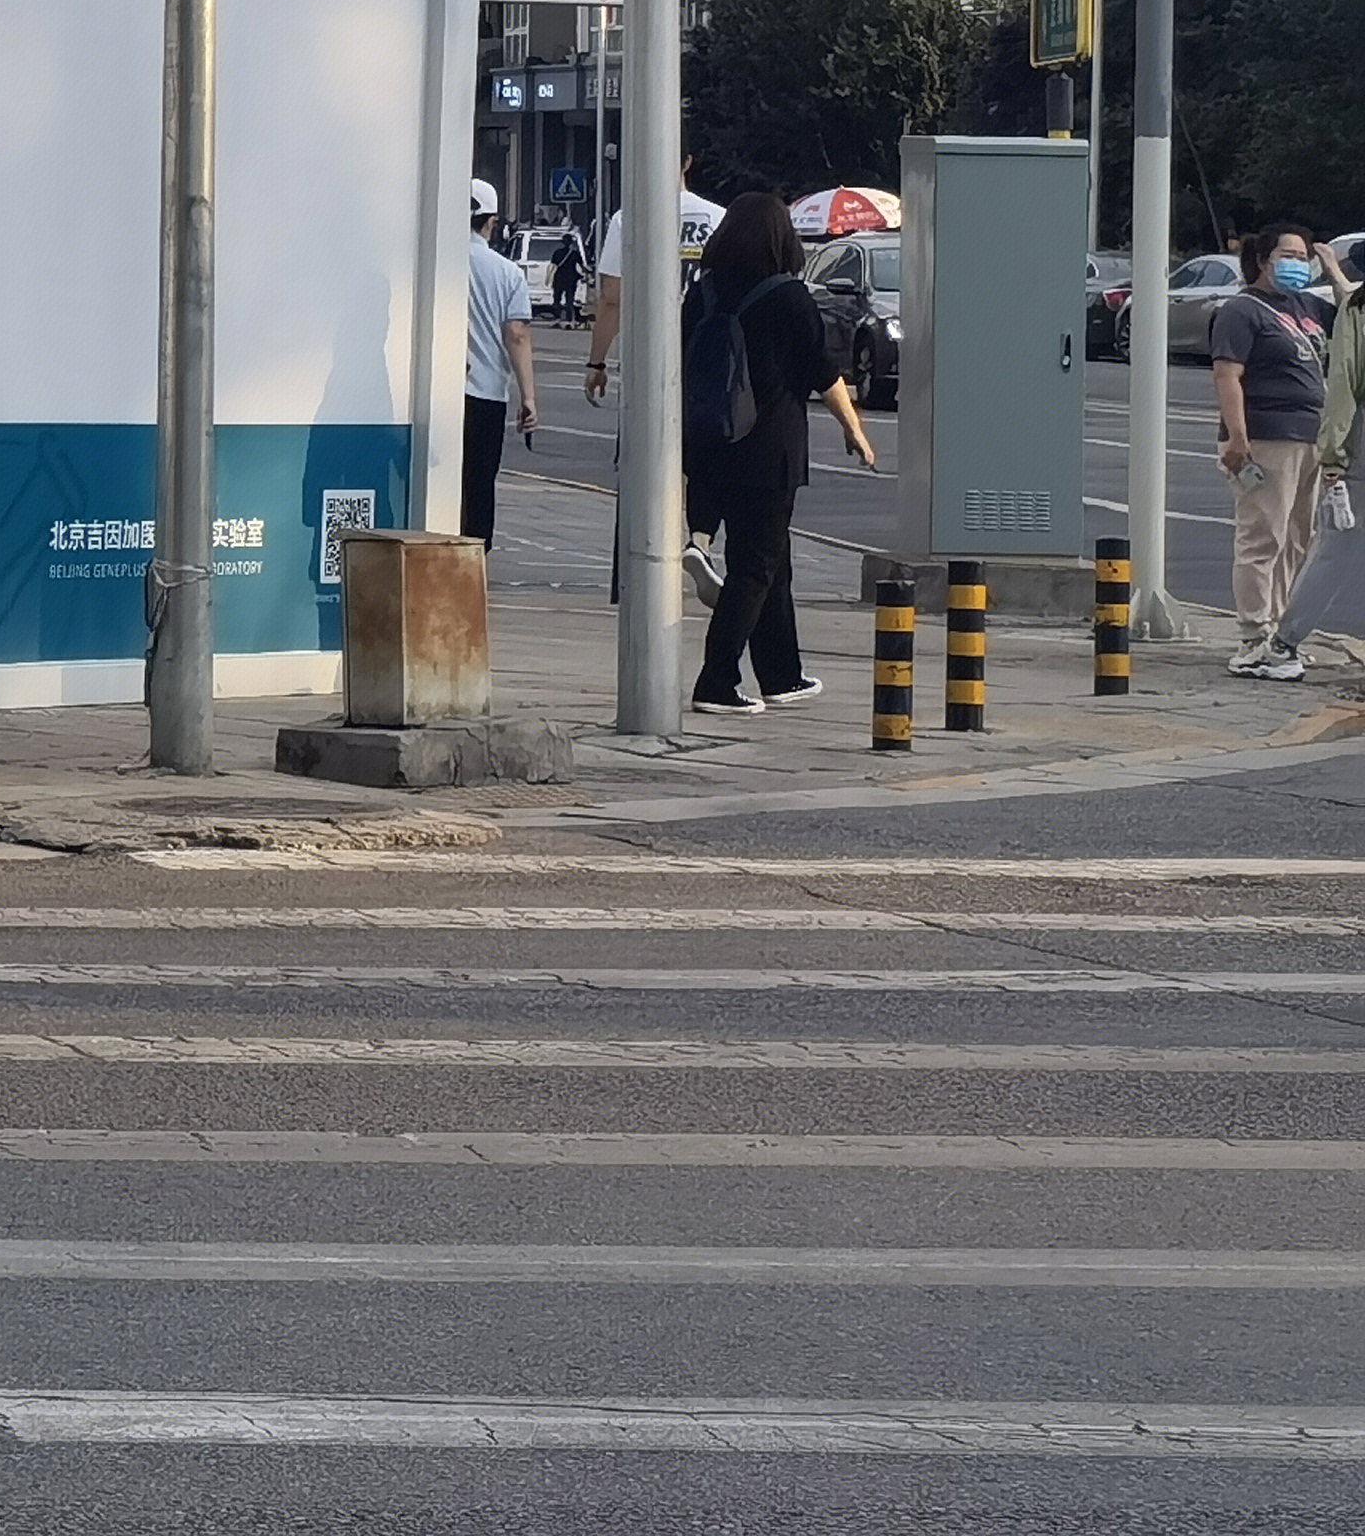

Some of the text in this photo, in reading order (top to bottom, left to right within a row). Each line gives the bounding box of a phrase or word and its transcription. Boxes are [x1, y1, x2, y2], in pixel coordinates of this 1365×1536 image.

[49, 517, 264, 551] 北京吉因加医实验室
